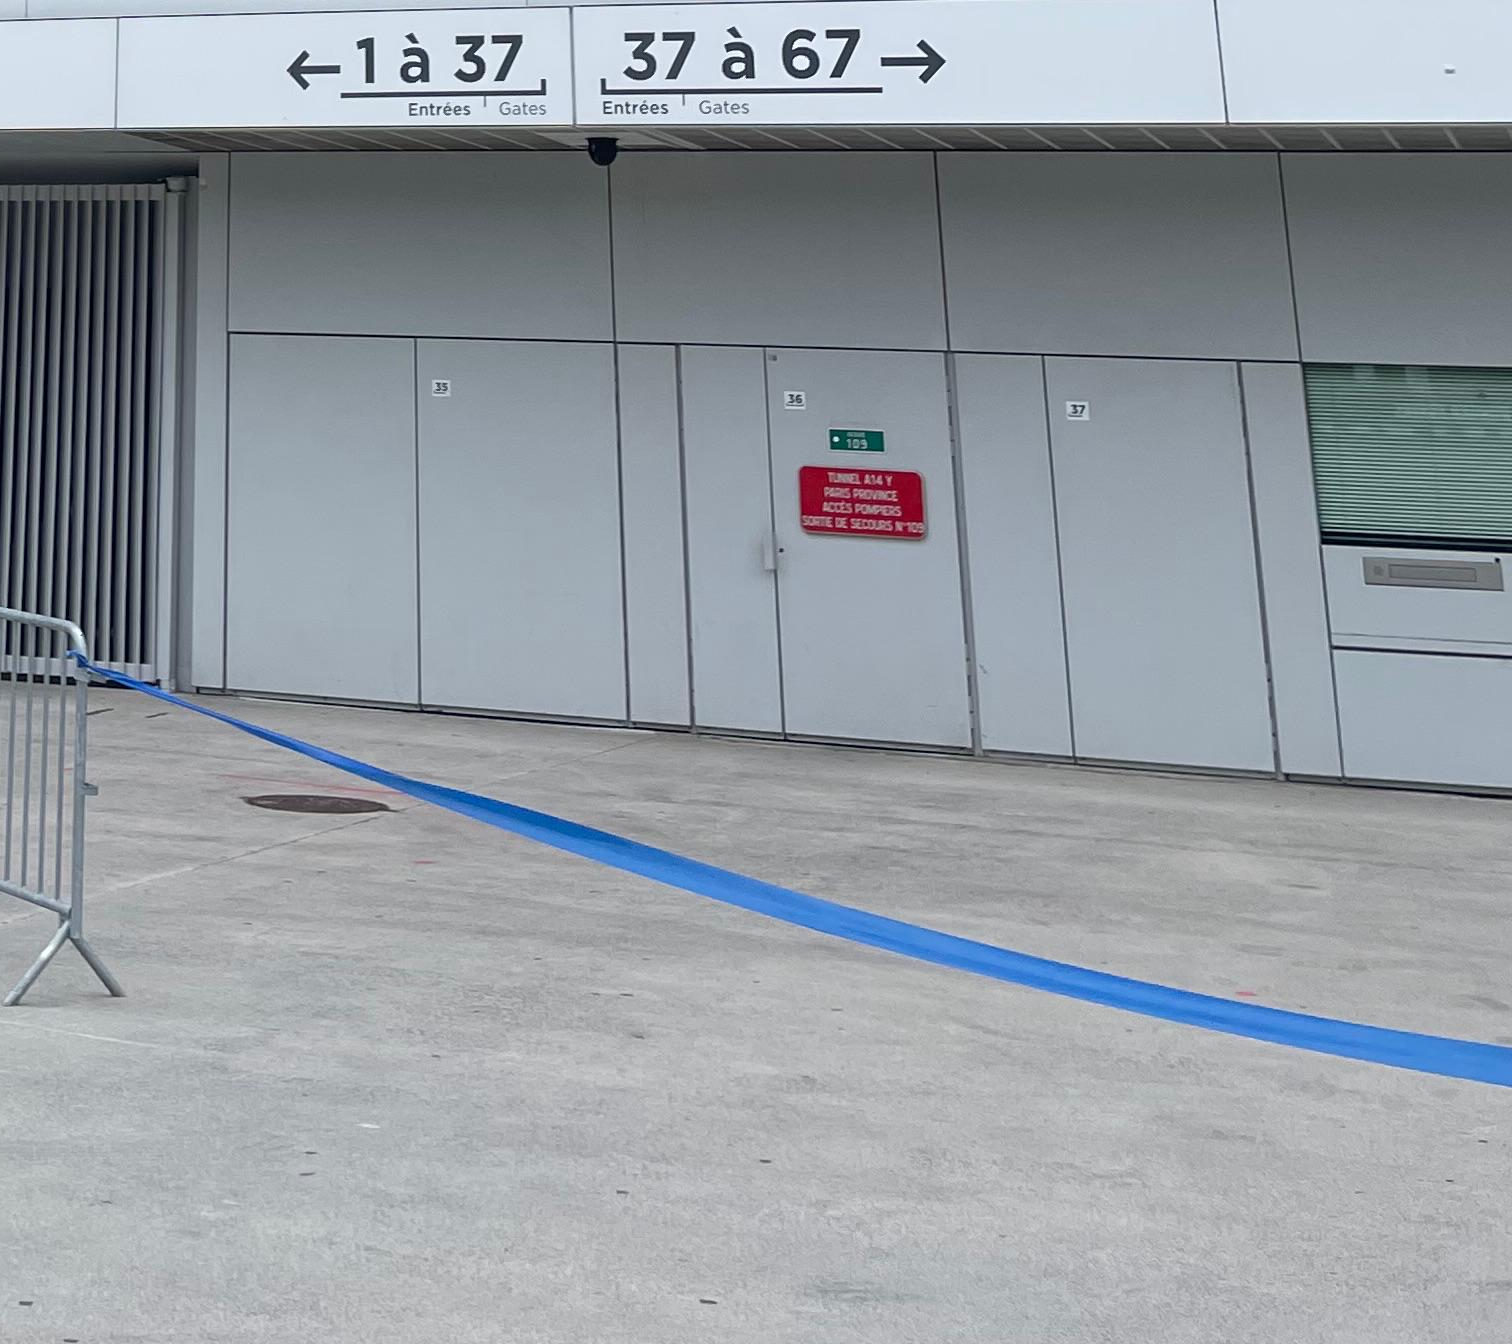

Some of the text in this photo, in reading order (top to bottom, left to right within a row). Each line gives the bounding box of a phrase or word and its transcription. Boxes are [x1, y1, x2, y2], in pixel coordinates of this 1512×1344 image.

[356, 34, 524, 84] 1 à 37
[623, 27, 861, 81] 37 à 67
[408, 100, 547, 117] Entrées Gates
[602, 98, 750, 116] Entrées Gates
[435, 382, 449, 392] 35
[788, 394, 803, 404] 36
[1070, 404, 1086, 415] 37
[864, 474, 884, 486] A14
[823, 487, 899, 502] PARIS PROVINCE
[854, 502, 903, 517] POMPIERS
[802, 515, 833, 528] SORTIE
[835, 517, 848, 529] DE
[850, 518, 894, 531] SECOURS
